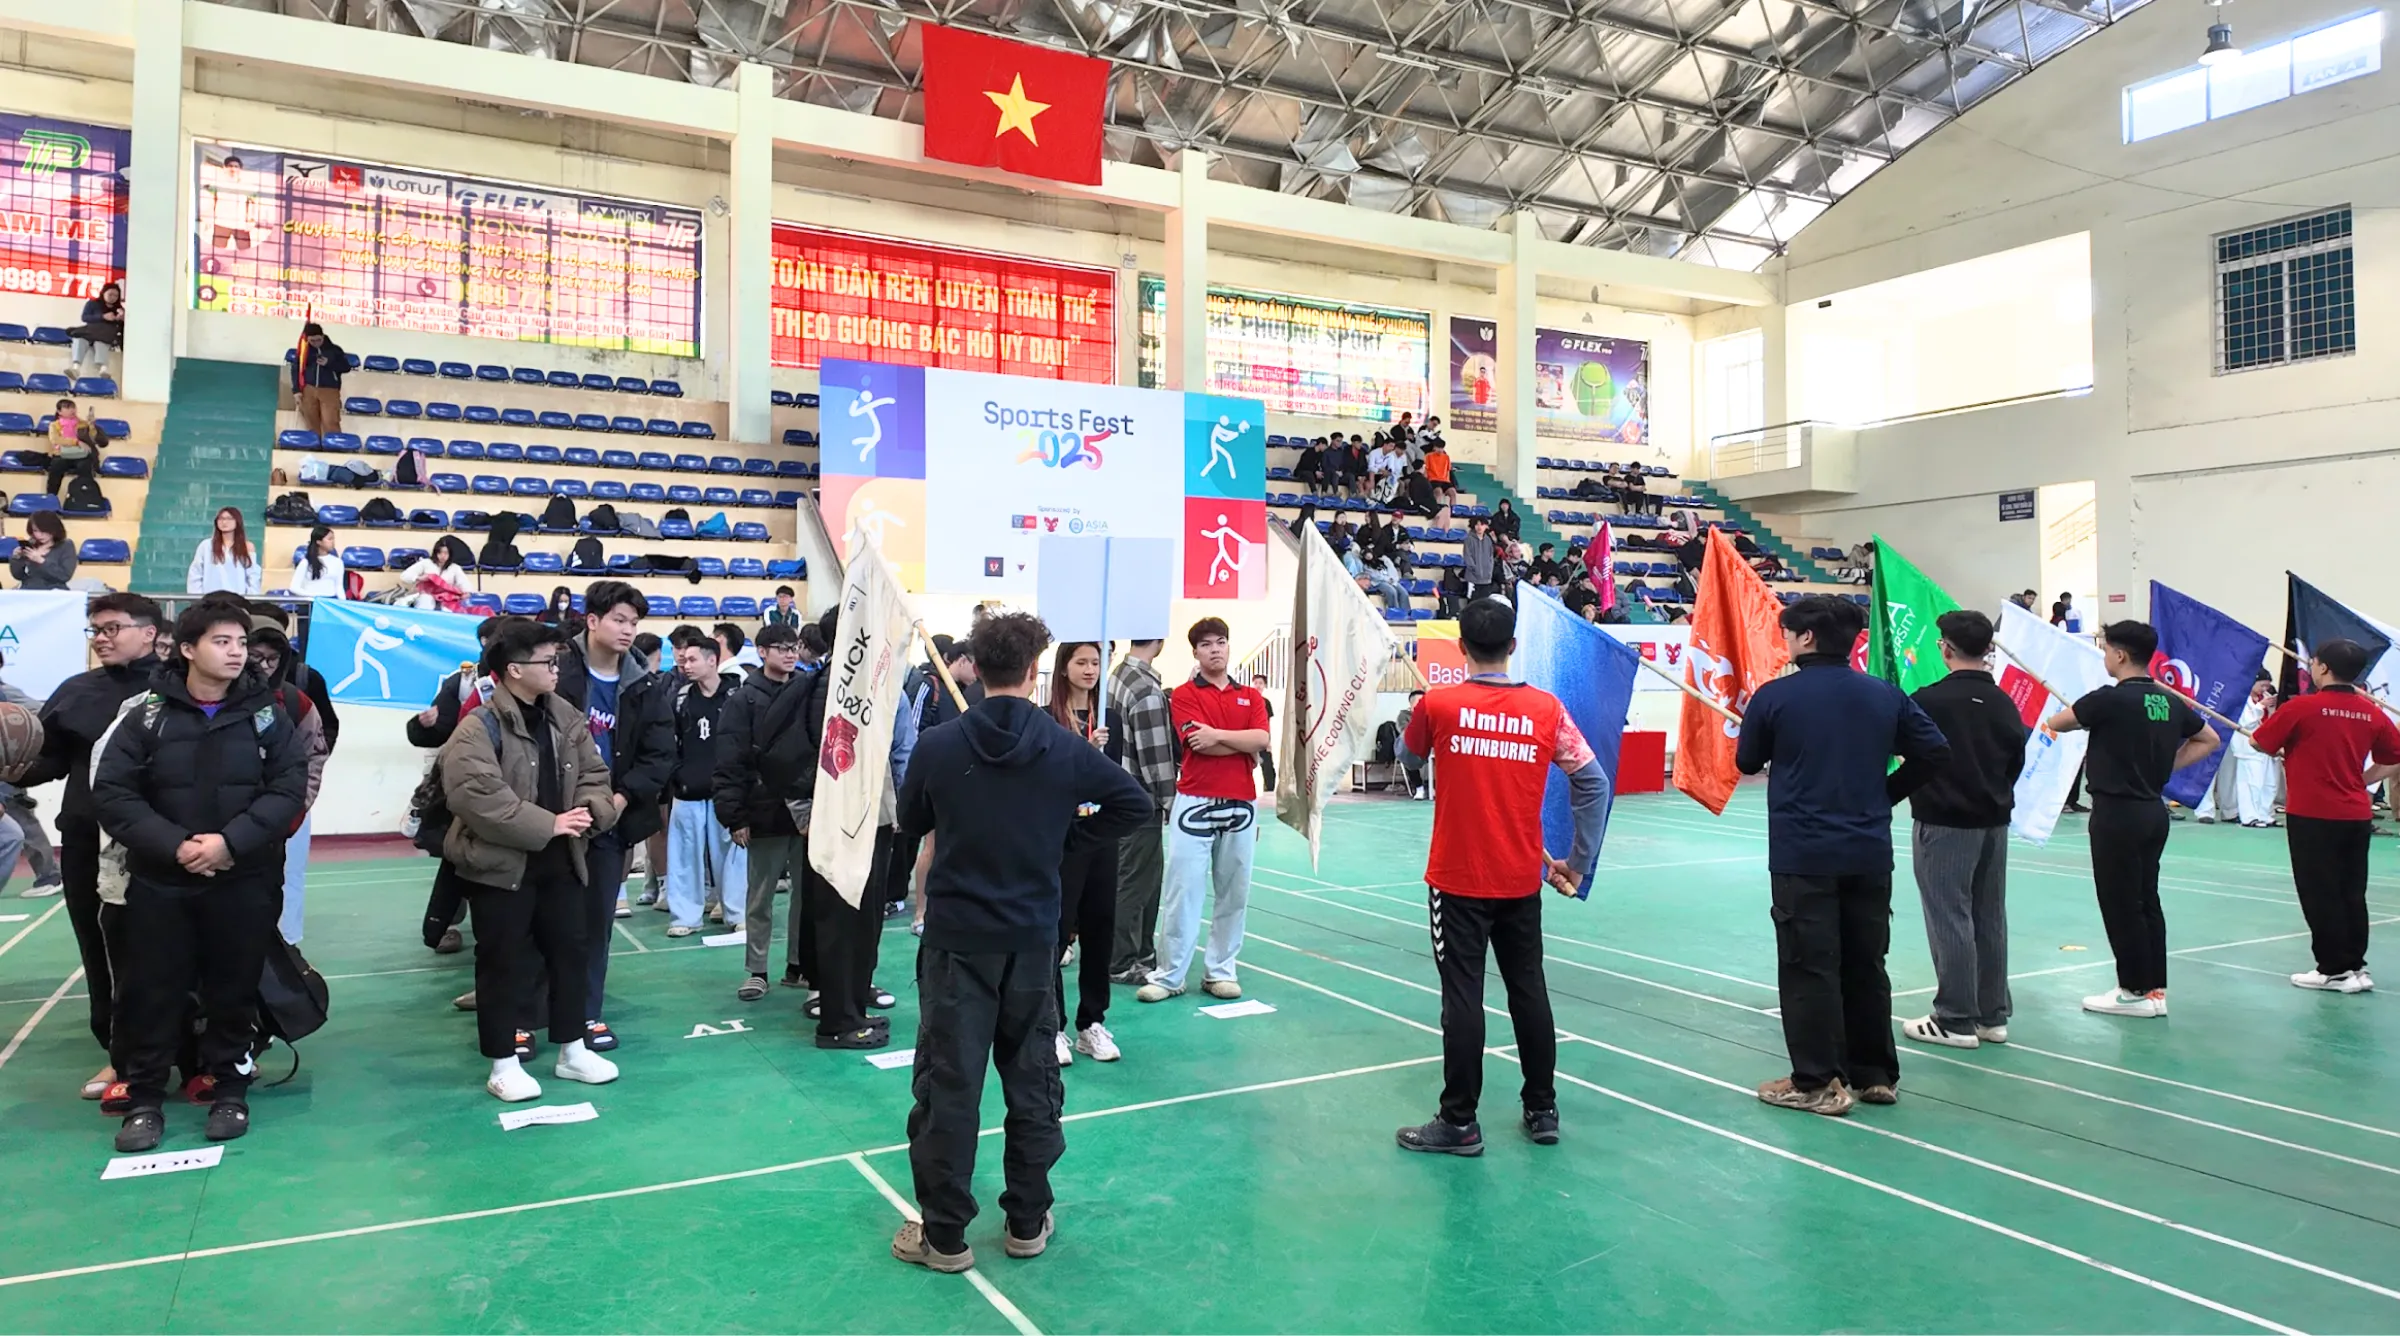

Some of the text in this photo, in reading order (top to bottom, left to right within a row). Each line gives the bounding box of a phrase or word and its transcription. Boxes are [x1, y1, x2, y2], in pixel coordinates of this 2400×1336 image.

[388, 178, 442, 195] LOTUS
[482, 193, 546, 213] FLEX
[610, 207, 651, 224] YONEX
[0, 266, 52, 293] 989
[770, 255, 1098, 325] TOÀN DÂN RÈN LUYỆN THÂN THỂ
[772, 306, 830, 341] THEO
[838, 315, 912, 350] GƯƠNG
[919, 320, 961, 356] BÁC
[966, 322, 995, 359] HỒ
[1000, 329, 1024, 362] VỸ
[1573, 339, 1602, 353] FLEX
[984, 400, 1135, 436] Sports Fest
[1016, 428, 1113, 471] 2025
[1085, 519, 1109, 530] ASIA
[837, 626, 871, 705] CLICK
[1324, 689, 1356, 749] COOKING
[1459, 707, 1535, 736] Nminh
[2147, 706, 2169, 721] UNI
[2321, 707, 2373, 723] SWINBURNE
[1449, 734, 1538, 763] SWINBURNE
